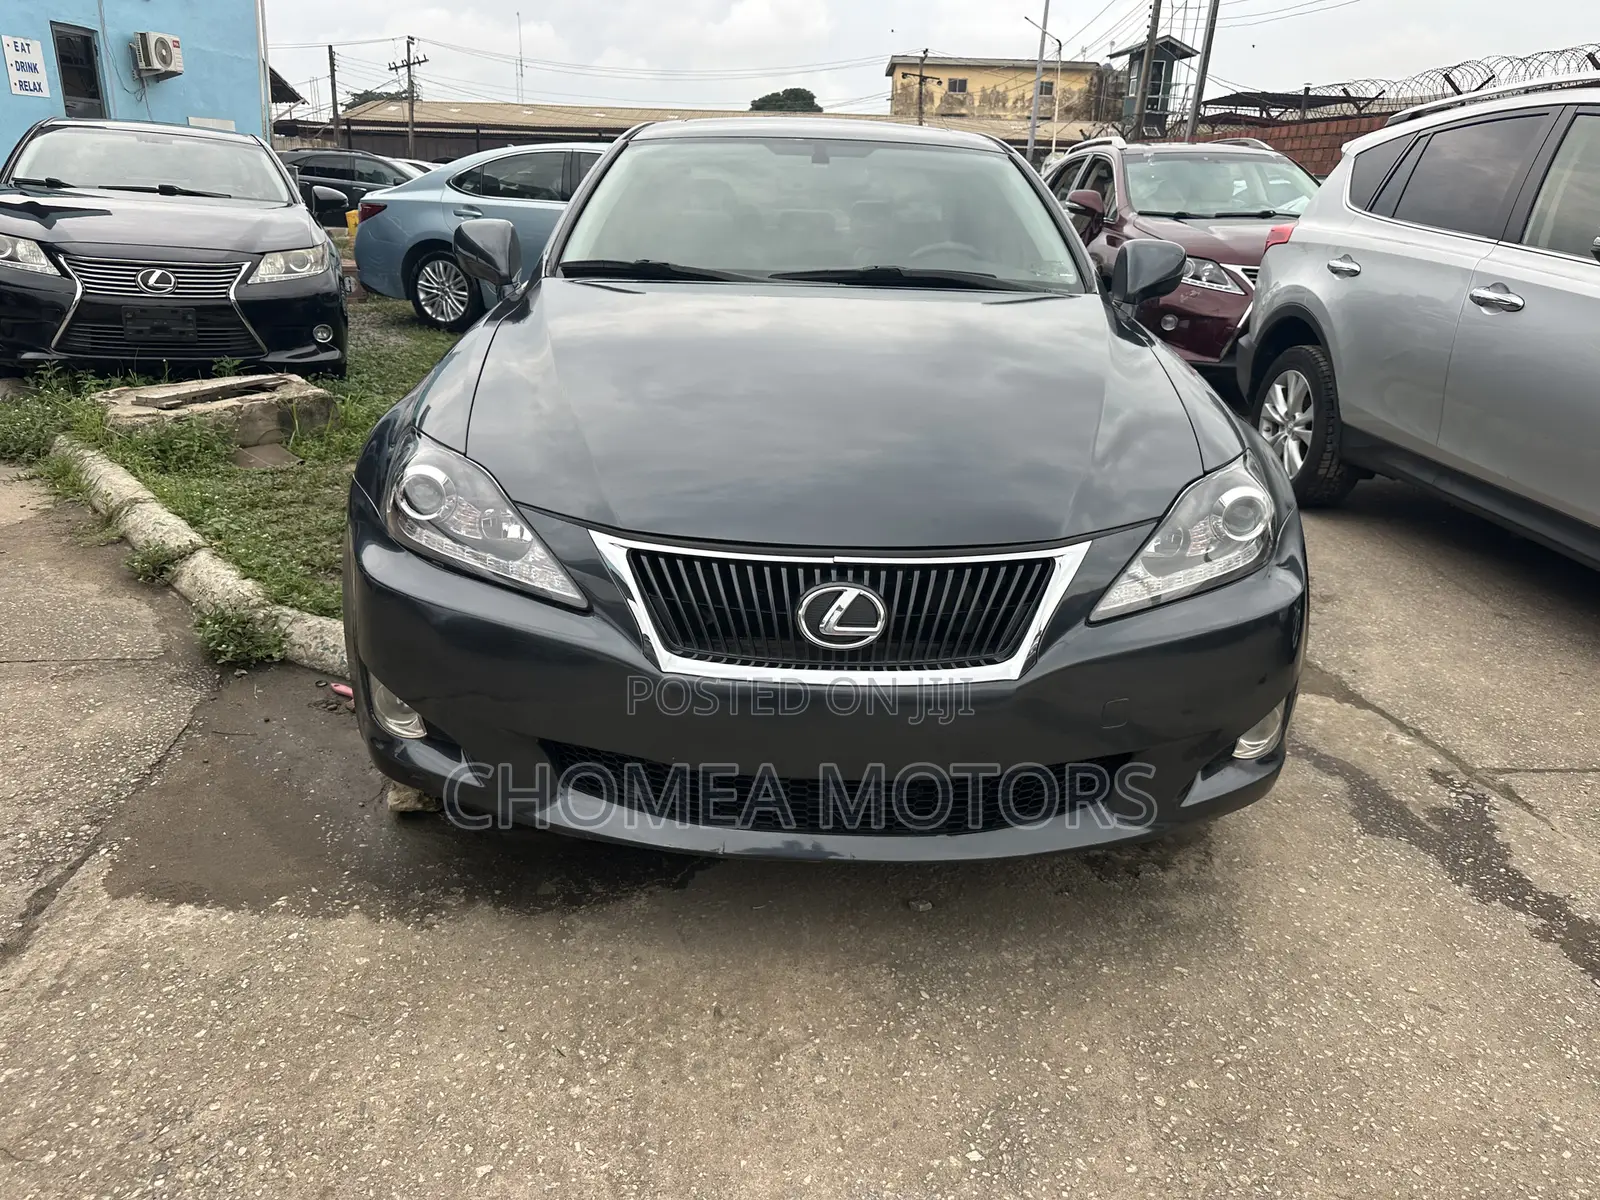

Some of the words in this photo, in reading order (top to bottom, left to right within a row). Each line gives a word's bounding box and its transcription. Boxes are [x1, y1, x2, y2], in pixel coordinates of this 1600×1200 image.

[13, 40, 31, 54] EAT
[15, 60, 39, 74] DRINK
[18, 79, 43, 93] RELAX
